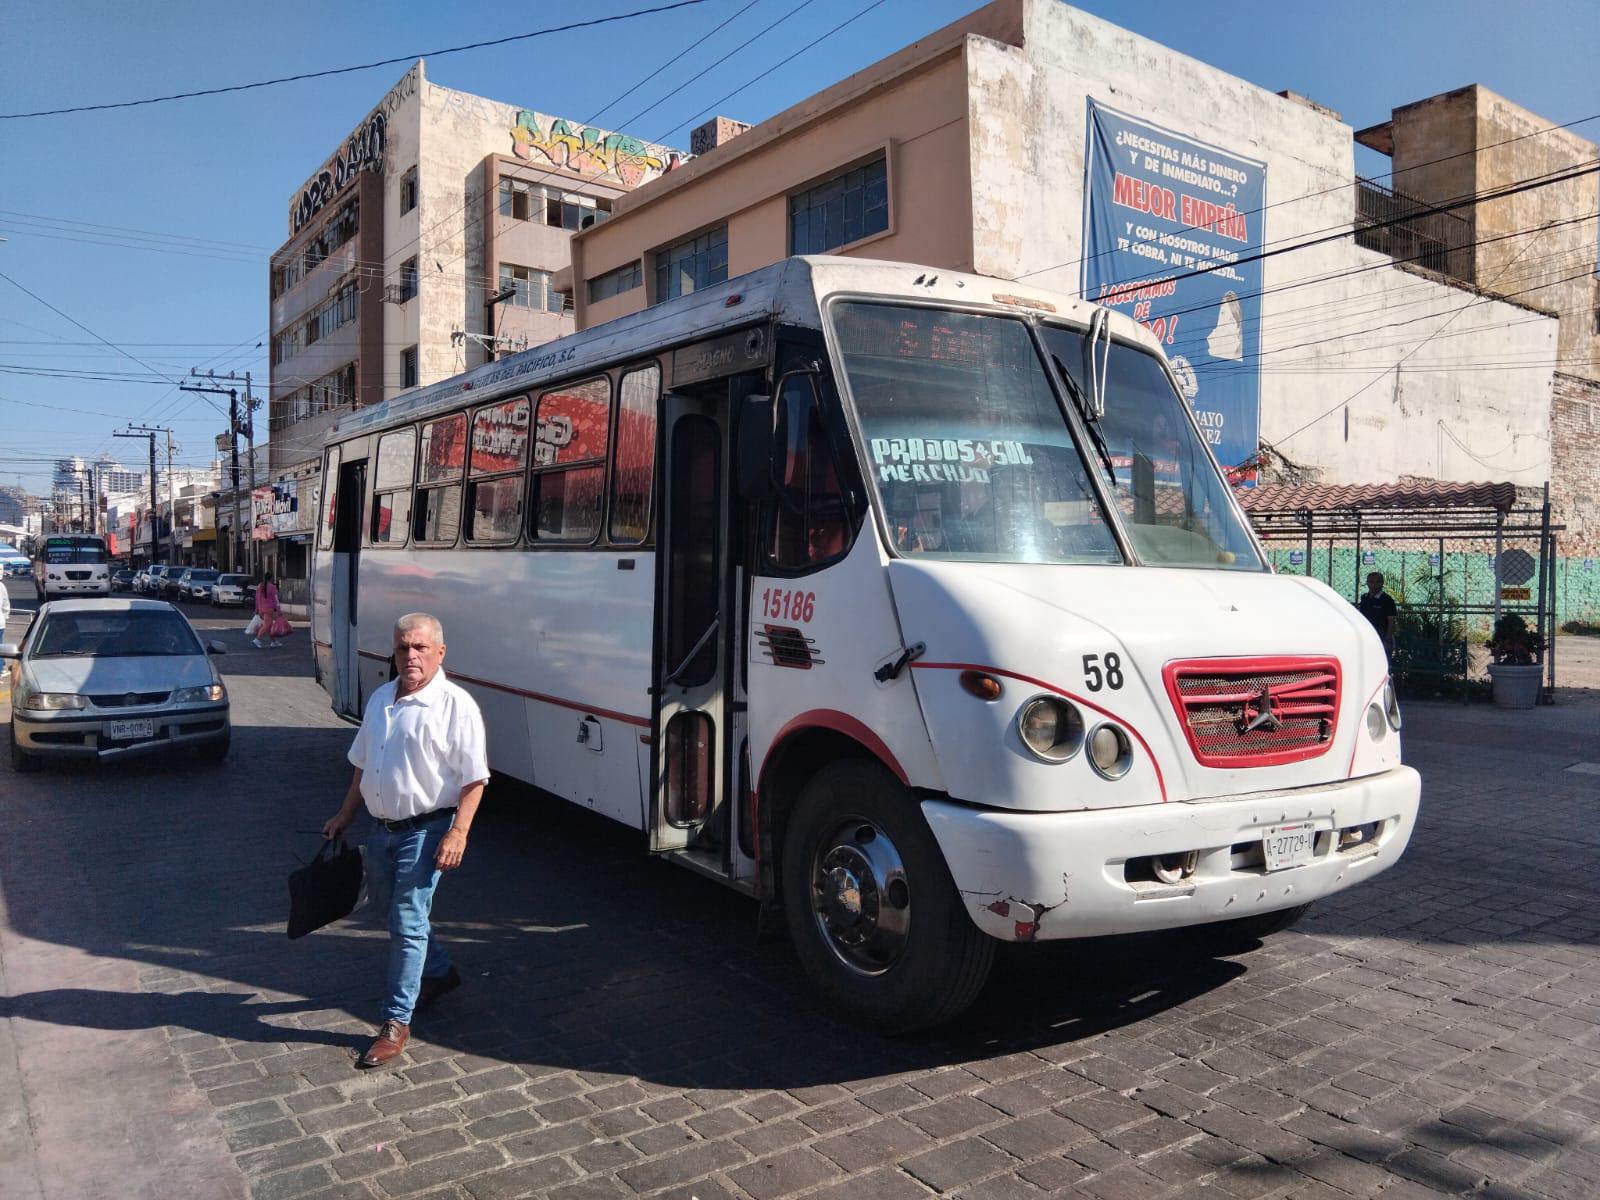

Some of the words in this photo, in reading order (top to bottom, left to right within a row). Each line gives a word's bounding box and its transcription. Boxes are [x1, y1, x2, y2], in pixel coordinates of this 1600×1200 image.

[1116, 131, 1179, 162] ¿NECESITAS
[1181, 152, 1206, 172] MÁS
[1209, 162, 1247, 184] DINERO
[1130, 151, 1138, 165] Y
[1145, 156, 1159, 173] DE
[1162, 163, 1238, 198] INMEDIATO...?
[1113, 172, 1176, 222] MEJOR
[1180, 194, 1248, 243] EMPEÑA
[1118, 237, 1129, 252] TE
[1132, 242, 1168, 264] COBRA,
[1170, 252, 1182, 266] NI
[1184, 256, 1195, 269] TE
[1126, 222, 1134, 235] Y
[1136, 226, 1157, 242] CON
[1160, 232, 1210, 256] NOSOTROS
[1212, 247, 1239, 263] NADIE
[1134, 300, 1151, 320] DE
[871, 438, 975, 464] PRADOS
[763, 587, 816, 623] 15186
[1082, 651, 1124, 692] 58
